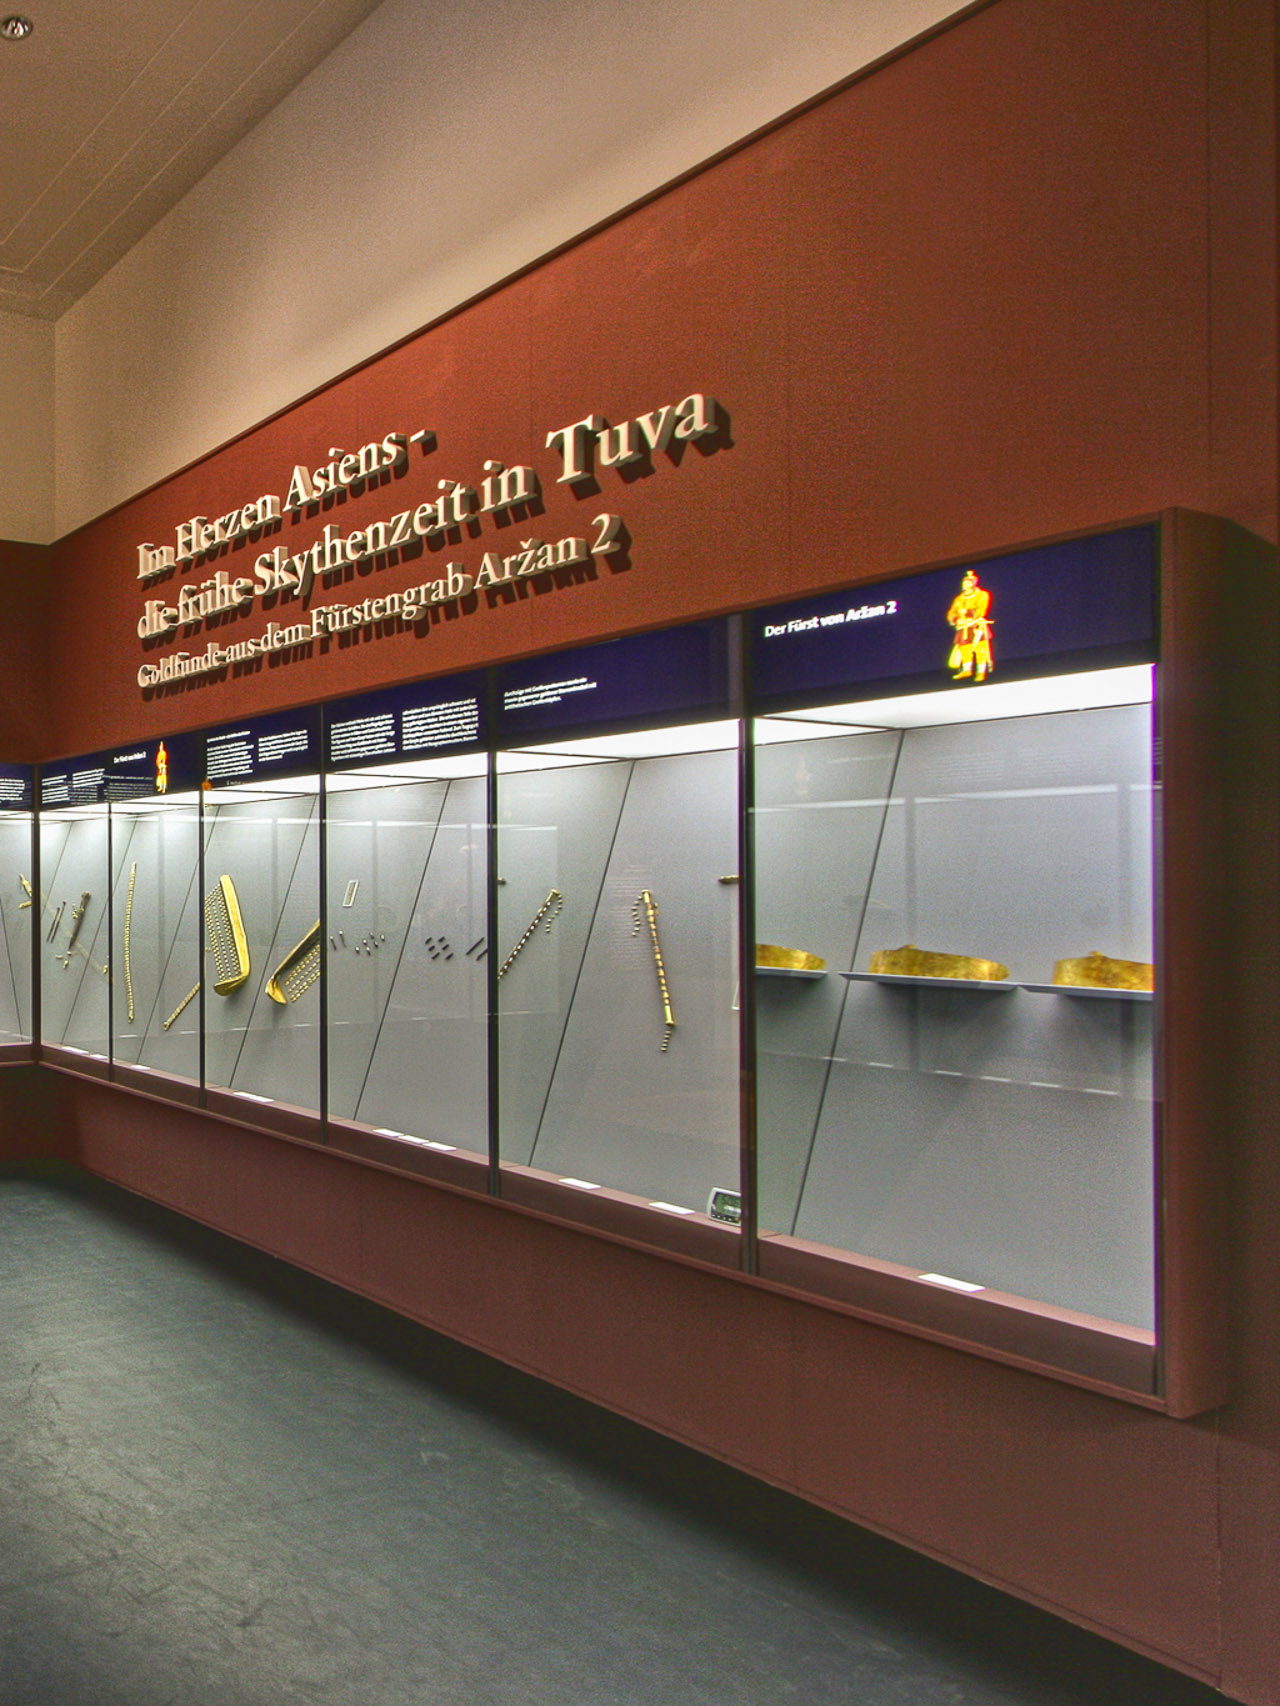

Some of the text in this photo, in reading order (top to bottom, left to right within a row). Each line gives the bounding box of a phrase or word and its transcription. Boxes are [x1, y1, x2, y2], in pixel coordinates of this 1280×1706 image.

[137, 543, 176, 579] Im
[176, 494, 282, 562] Herzen
[282, 432, 407, 512] Asiens
[138, 393, 718, 639] die frühe Skythenzeit in Tuva
[137, 513, 623, 688] Goldfunde aus dem Fürstengrab Aržan 2
[765, 625, 787, 637] Der
[787, 616, 820, 633] Fürst
[820, 613, 845, 626] von
[886, 600, 898, 614] 2
